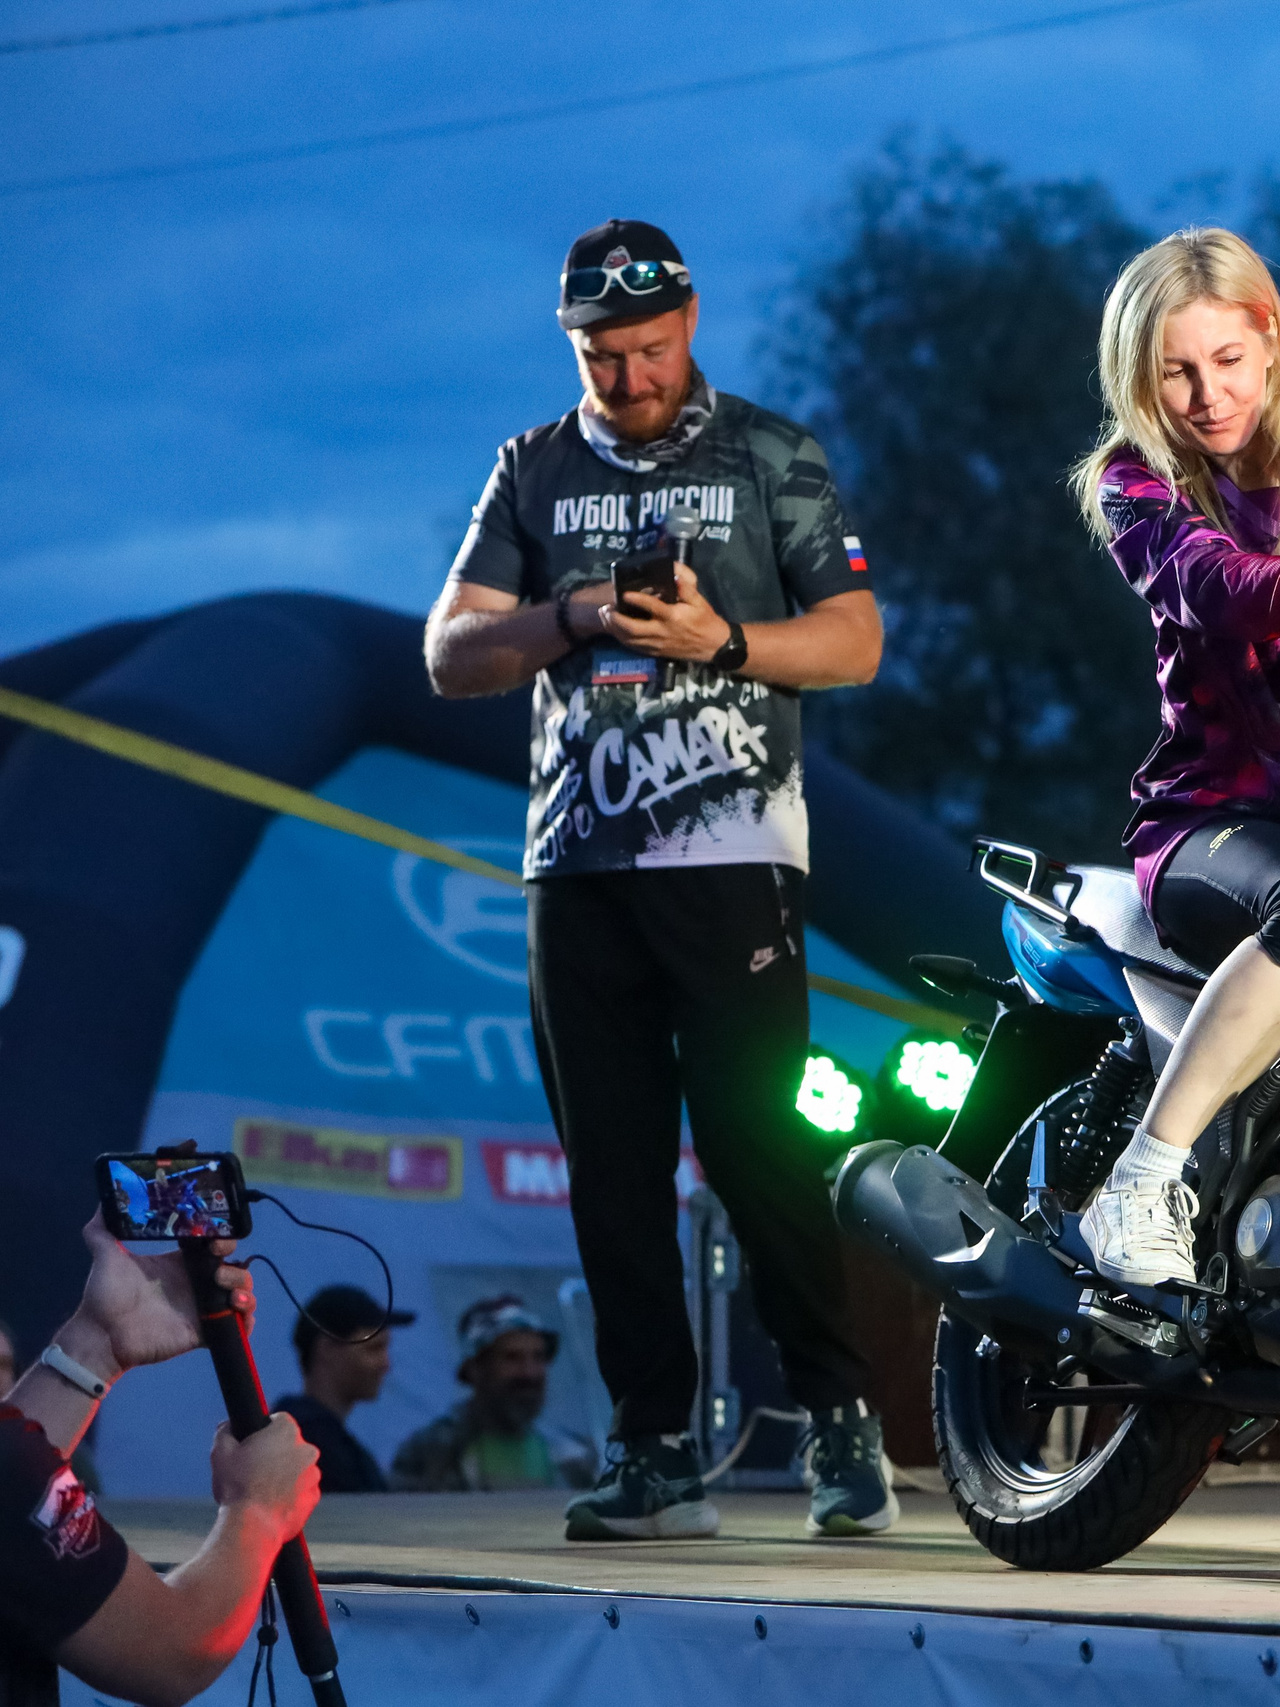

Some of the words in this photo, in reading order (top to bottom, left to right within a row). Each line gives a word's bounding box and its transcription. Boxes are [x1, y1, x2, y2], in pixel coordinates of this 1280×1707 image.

[553, 493, 633, 536] КУБОК
[589, 705, 769, 816] САМАРА
[305, 1008, 540, 1084] CFM
